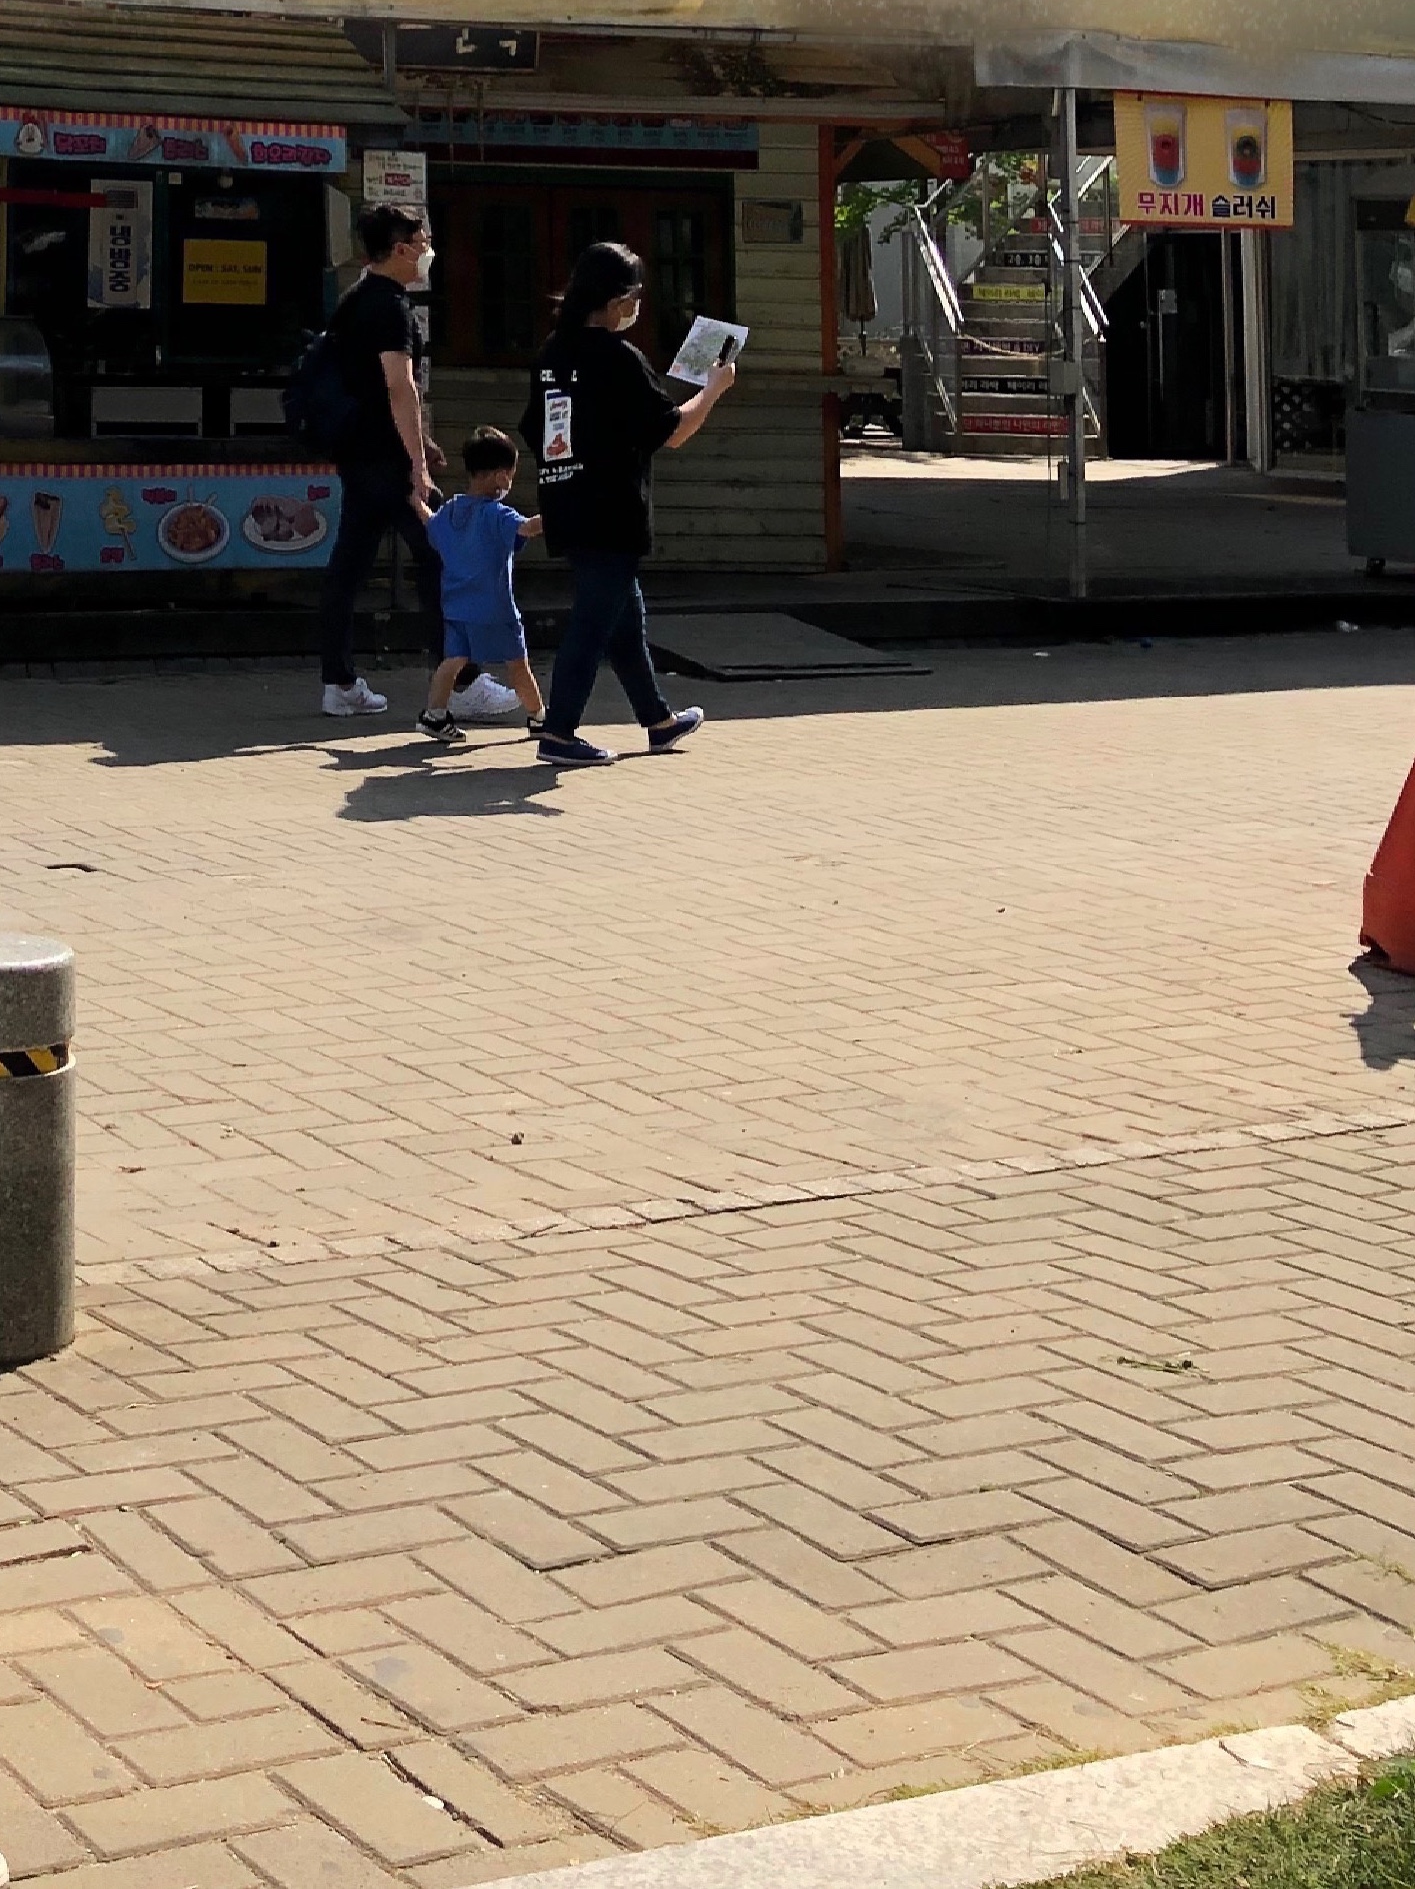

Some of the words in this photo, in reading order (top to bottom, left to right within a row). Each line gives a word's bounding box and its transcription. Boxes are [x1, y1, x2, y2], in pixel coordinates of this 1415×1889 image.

[1137, 192, 1204, 217] 무지개
[1211, 194, 1277, 219] 슬러쉬
[109, 225, 131, 293] 냉방중
